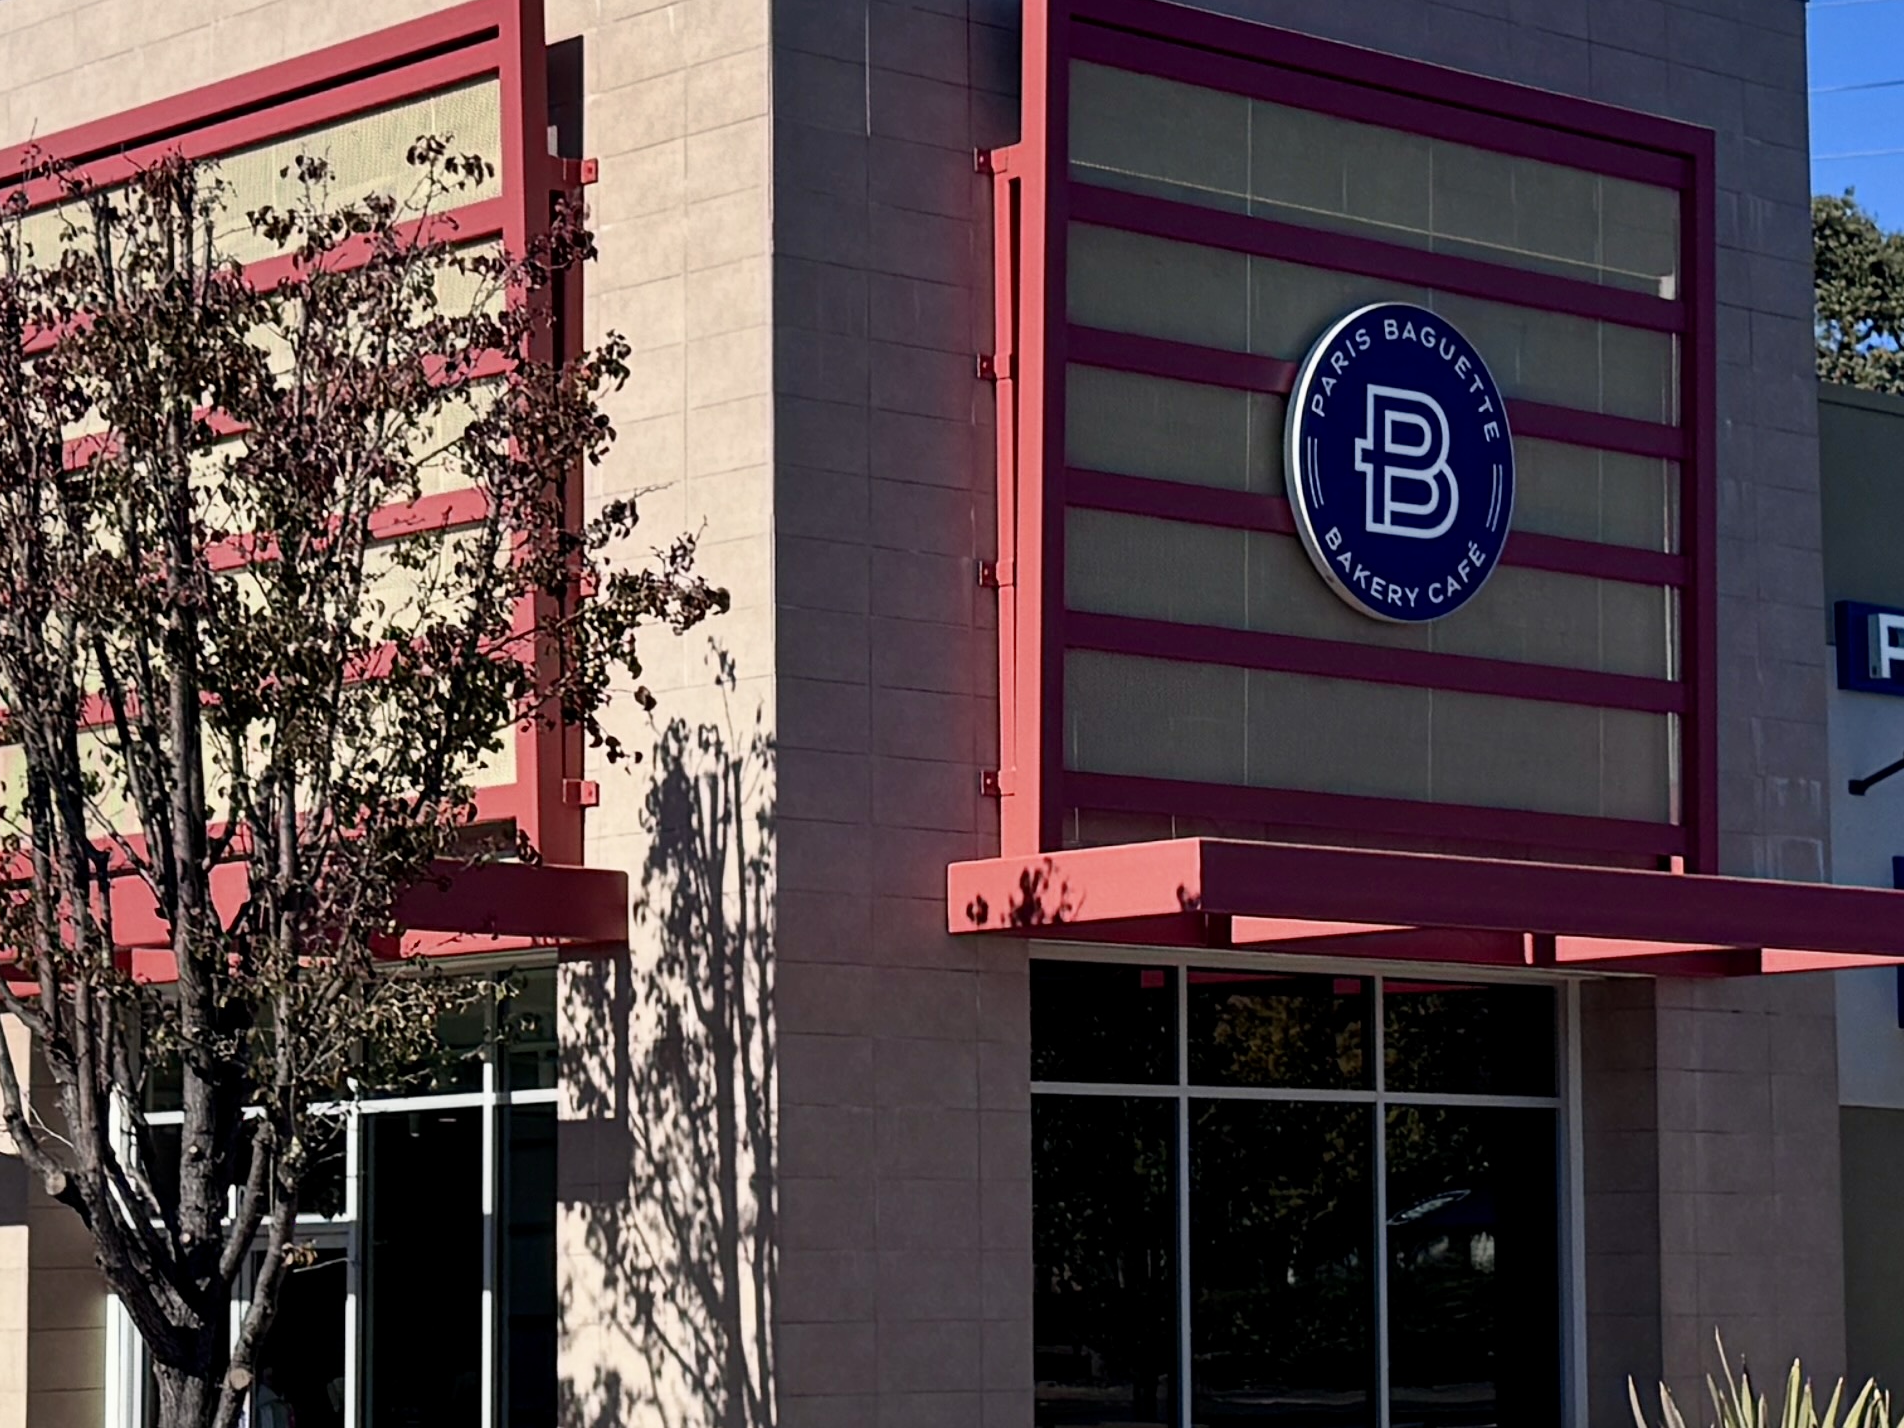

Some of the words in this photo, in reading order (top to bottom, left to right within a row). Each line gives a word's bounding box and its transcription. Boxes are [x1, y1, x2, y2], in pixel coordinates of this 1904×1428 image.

[1311, 328, 1371, 417] PARIS
[1383, 318, 1500, 443] BAGUETTE
[1324, 526, 1420, 608] BAKERY
[1428, 540, 1487, 604] CAFÉ
